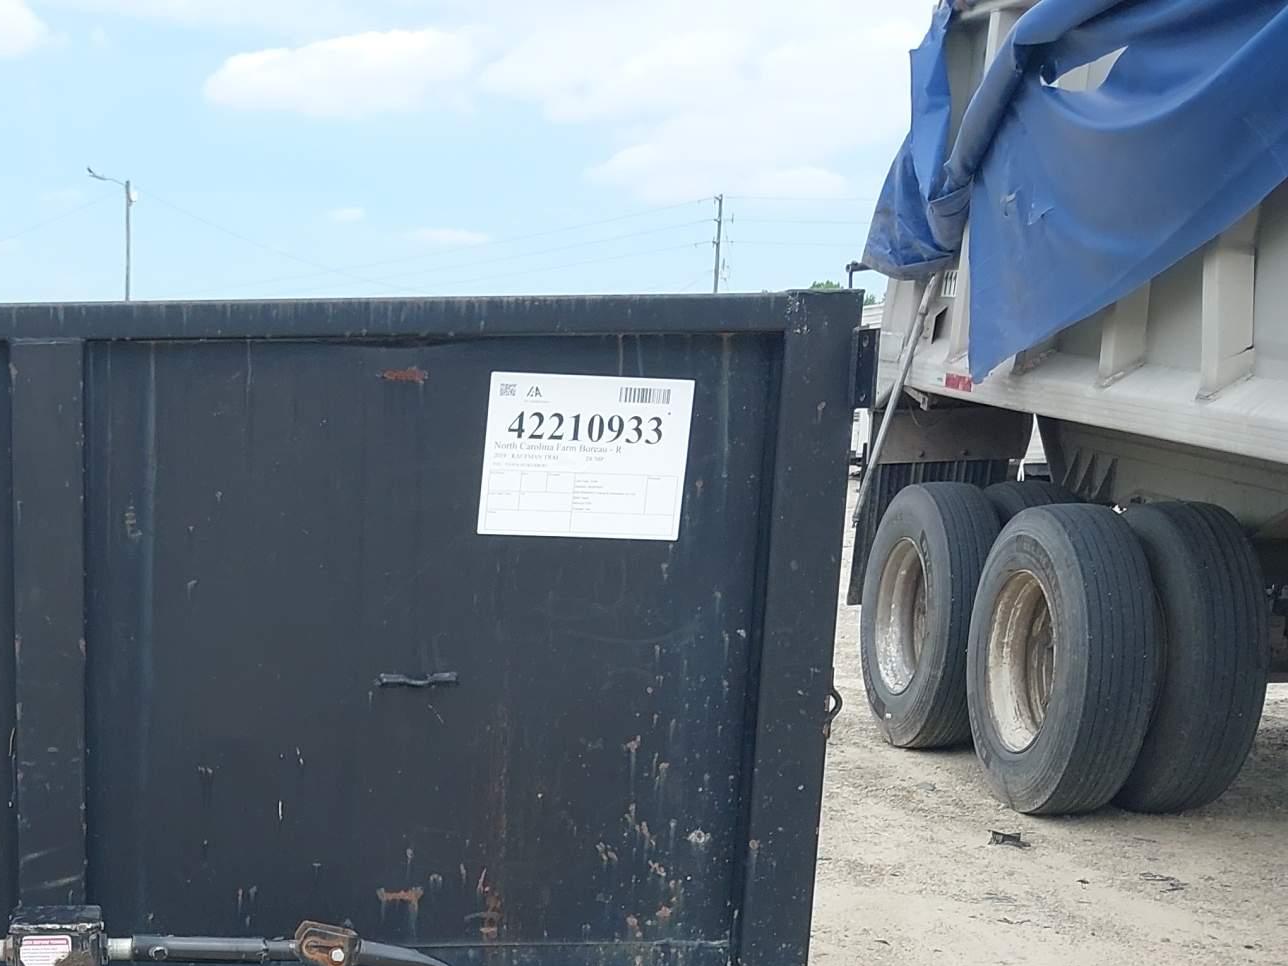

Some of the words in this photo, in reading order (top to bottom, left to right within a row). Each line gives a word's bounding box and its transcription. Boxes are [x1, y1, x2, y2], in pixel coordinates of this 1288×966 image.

[508, 411, 663, 444] 42210933
[494, 441, 518, 451] North
[519, 441, 554, 452] Carolina
